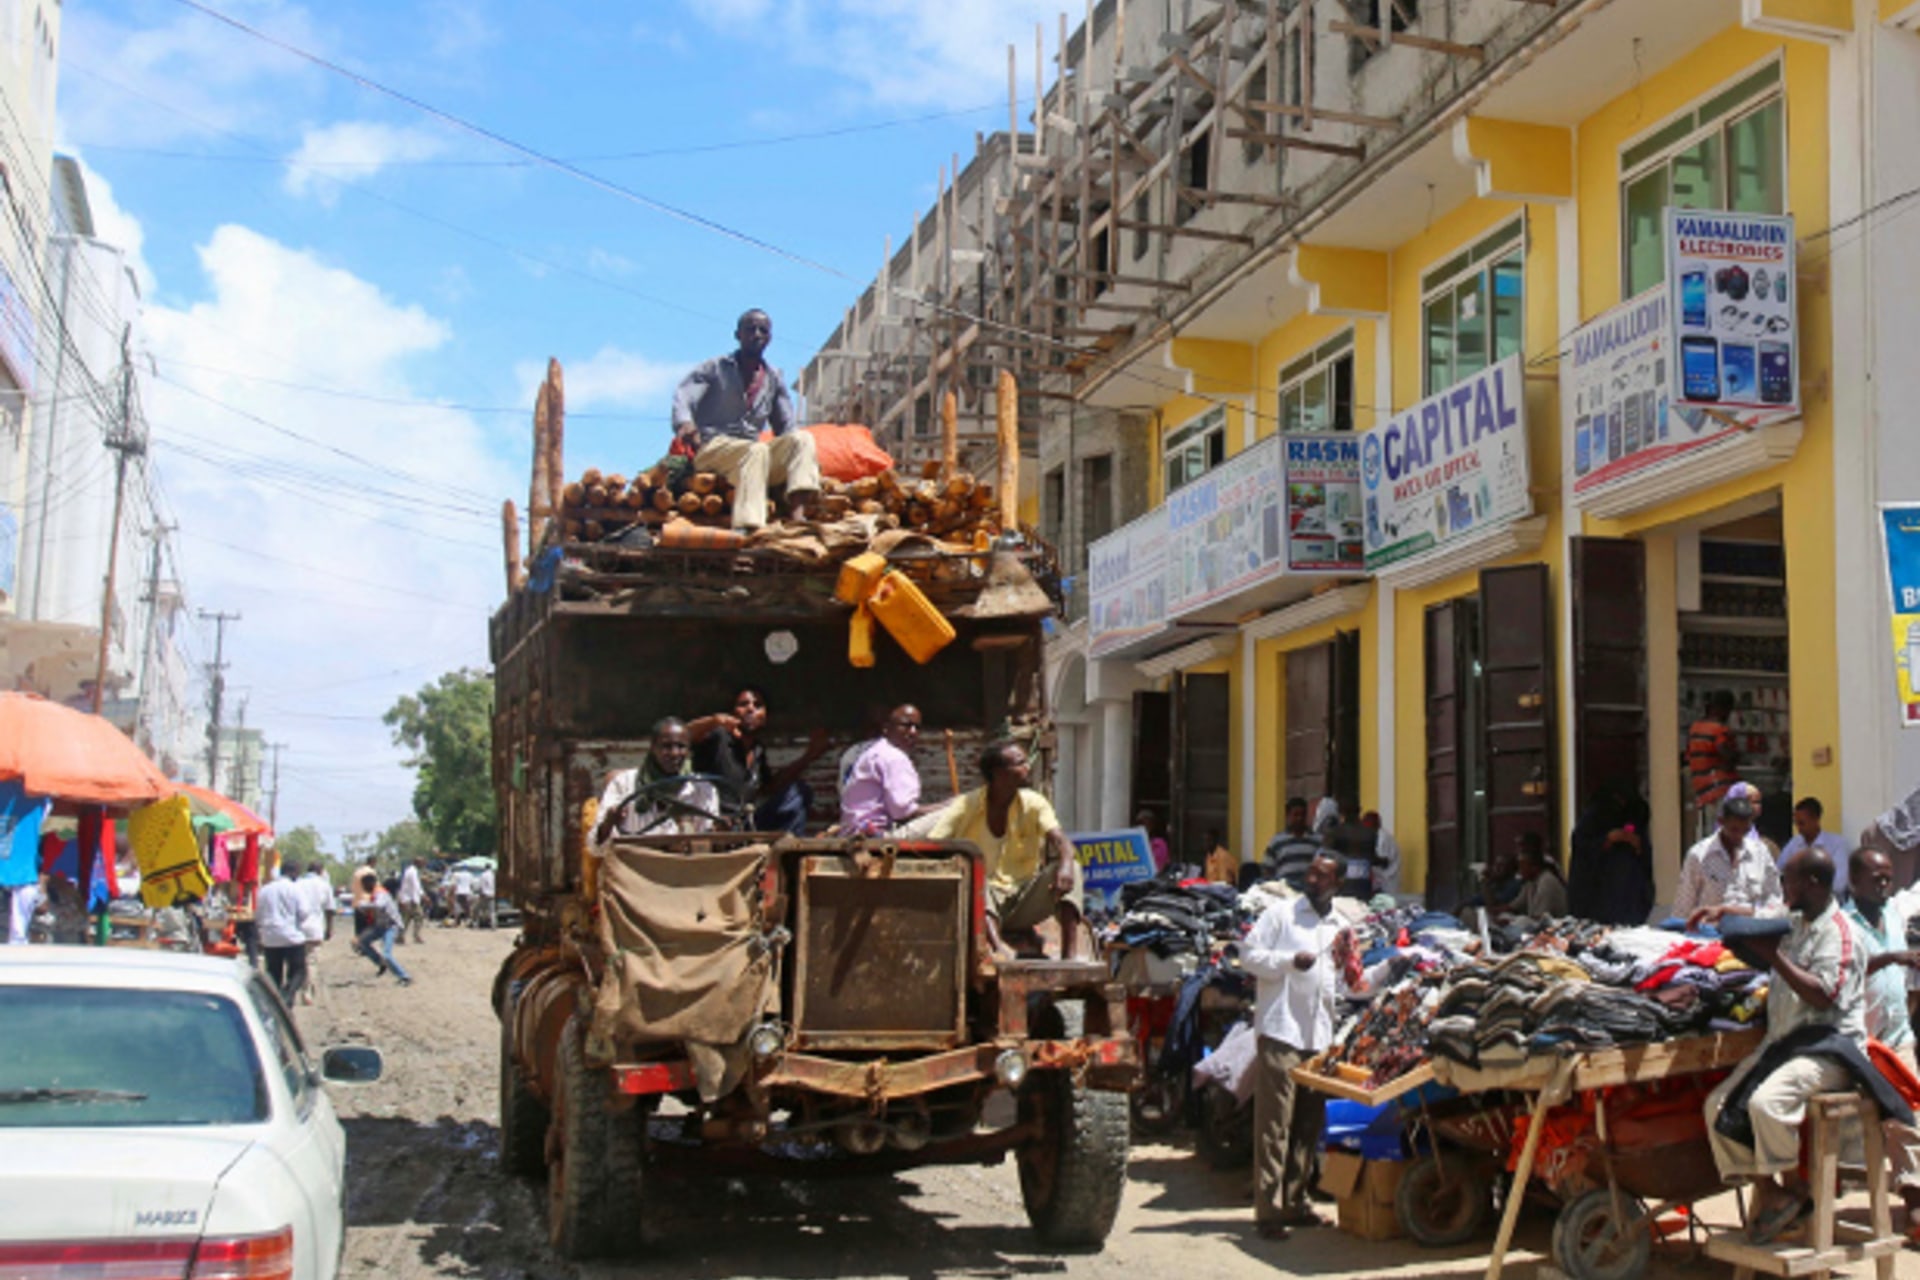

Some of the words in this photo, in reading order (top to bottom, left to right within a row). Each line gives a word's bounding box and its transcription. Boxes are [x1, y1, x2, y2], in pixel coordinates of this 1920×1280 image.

[1680, 239, 1784, 259] ELECTRONICS
[1384, 367, 1516, 481] CAPITAL
[1169, 479, 1218, 531] RASMI
[1072, 841, 1139, 867] APITAL
